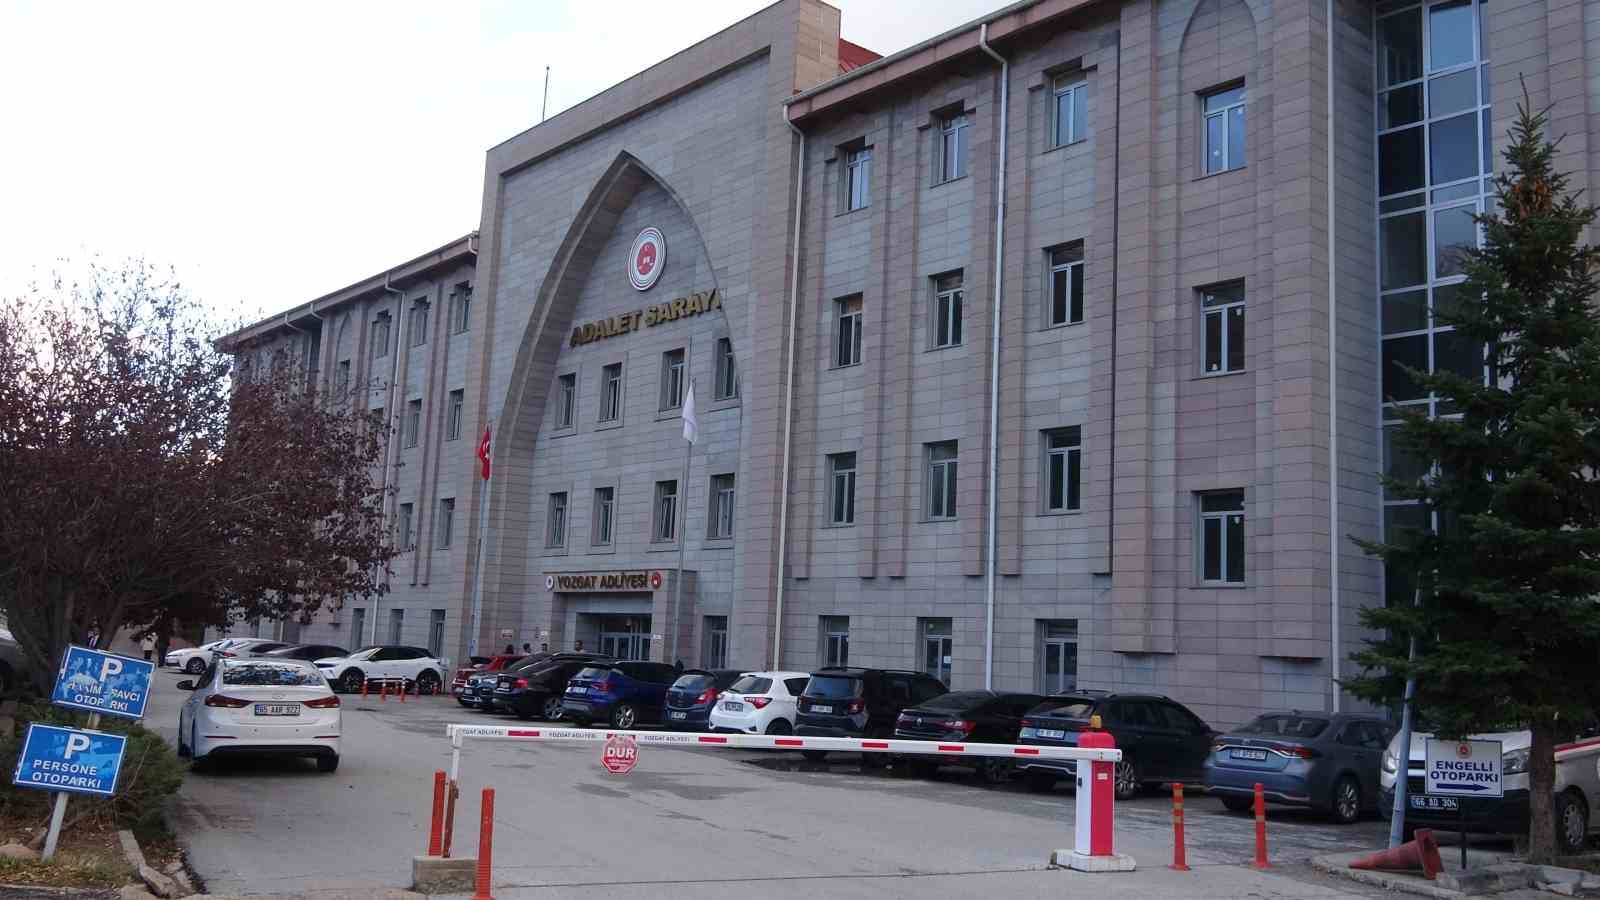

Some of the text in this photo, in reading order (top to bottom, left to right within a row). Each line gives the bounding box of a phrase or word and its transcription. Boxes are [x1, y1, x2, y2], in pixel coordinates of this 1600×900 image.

[569, 309, 643, 348] ADALET
[558, 575, 597, 590] YOZGAT
[100, 656, 123, 682] P
[74, 694, 129, 712] OTOPRKI
[64, 733, 90, 760] P
[607, 746, 635, 760] DUR
[32, 772, 102, 788] OTOPARKI
[1431, 771, 1499, 783] OTOPARKI
